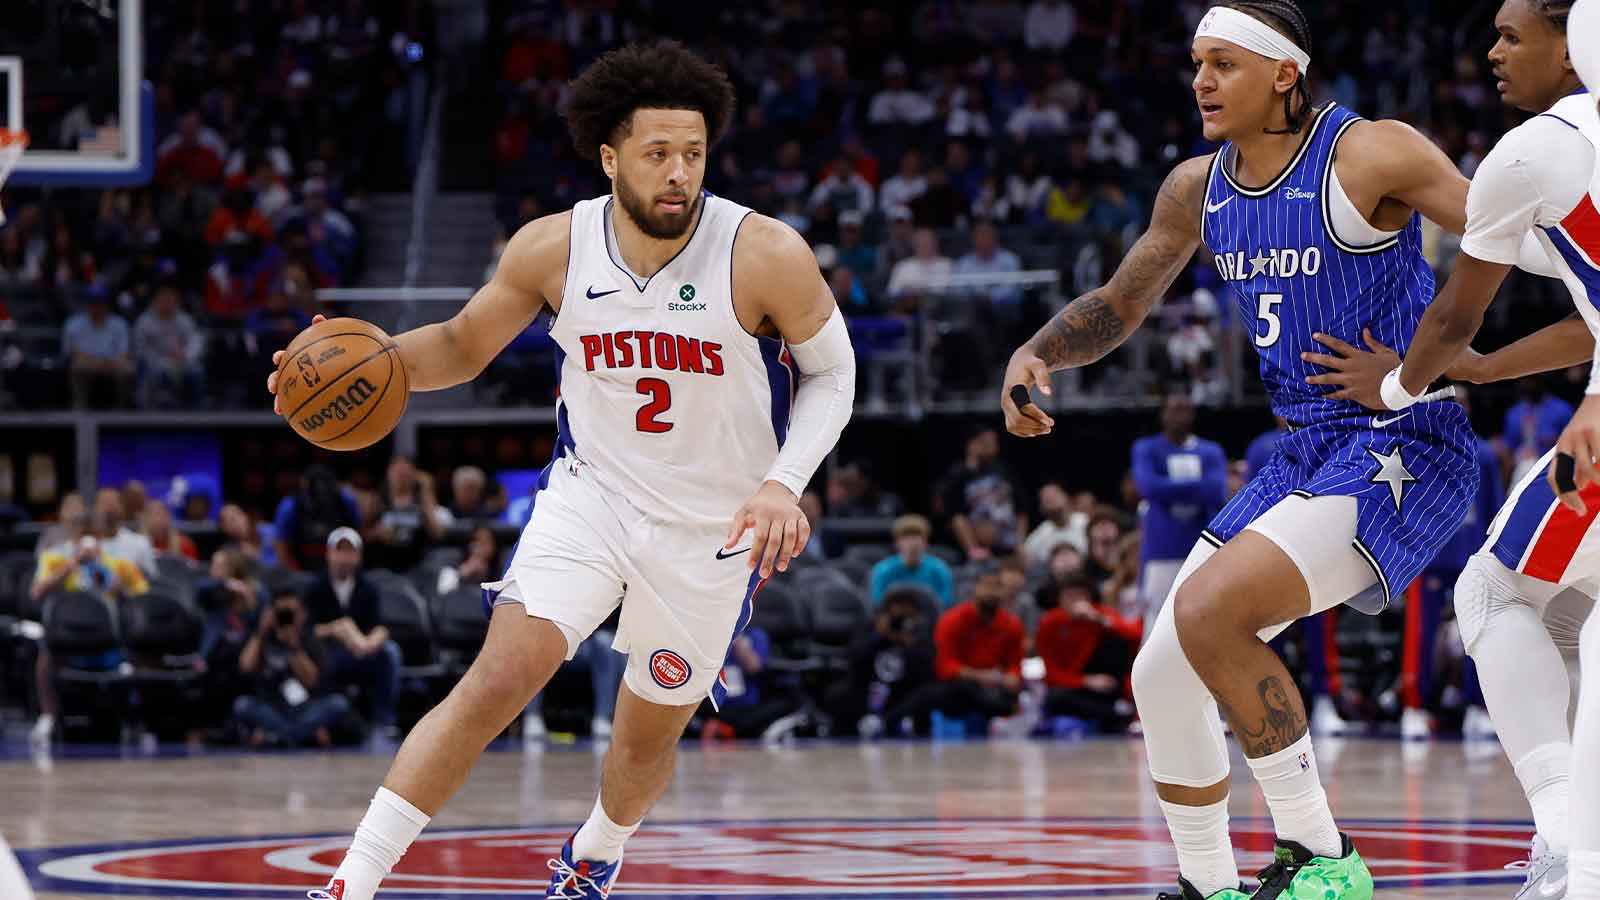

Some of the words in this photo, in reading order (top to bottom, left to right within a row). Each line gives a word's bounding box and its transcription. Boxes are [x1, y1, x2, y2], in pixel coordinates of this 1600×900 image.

[668, 303, 706, 311] StockX
[1255, 294, 1283, 347] 5
[579, 331, 724, 376] PISTONS
[300, 377, 377, 432] Wilson
[636, 377, 674, 433] 2
[656, 661, 681, 681] PISTONS
[660, 657, 684, 676] DETROIT
